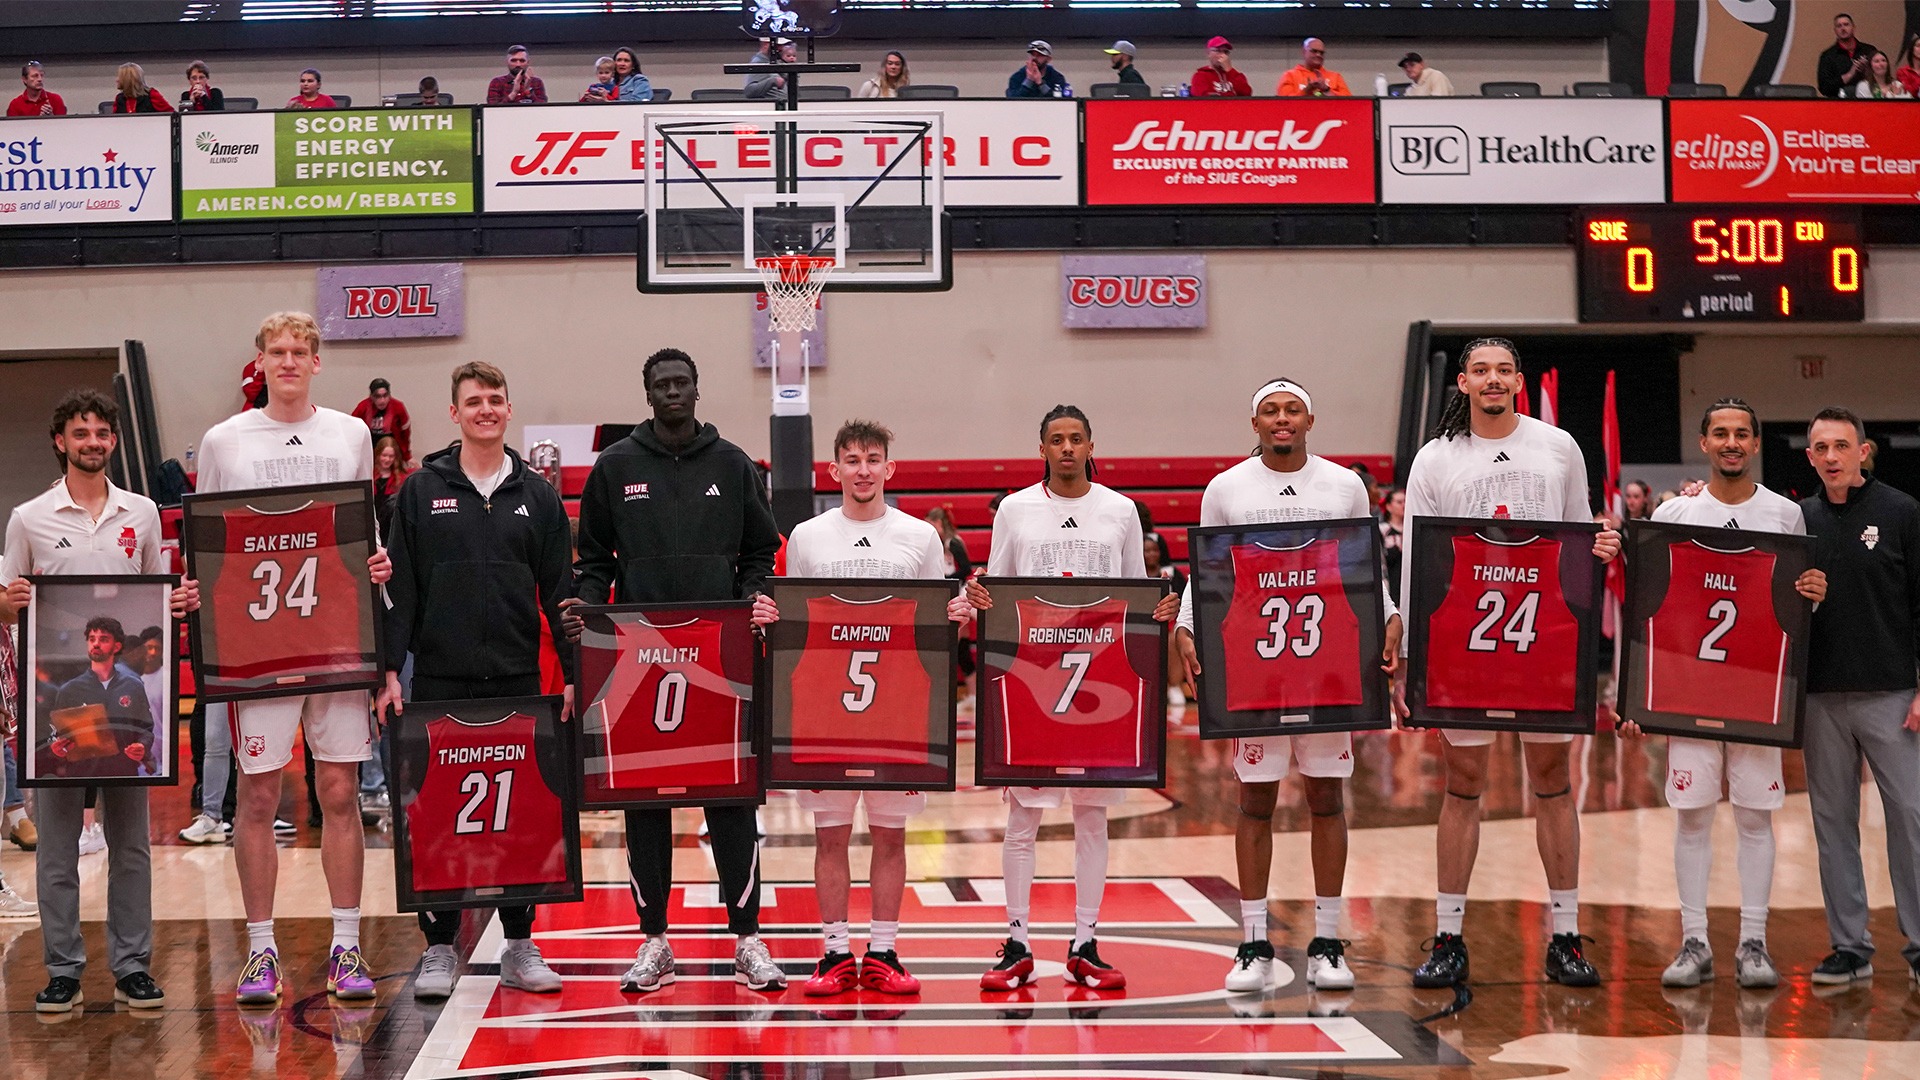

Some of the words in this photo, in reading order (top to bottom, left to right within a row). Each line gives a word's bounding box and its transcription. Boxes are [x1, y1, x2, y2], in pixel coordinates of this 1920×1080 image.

[295, 116, 378, 134] SCORE
[388, 114, 453, 131] WITH
[1112, 119, 1343, 151] Schnucks
[1783, 130, 1871, 153] Eclipse.
[210, 141, 259, 156] Ameren
[295, 138, 395, 156] ENERGY
[631, 135, 1052, 170] ELECTRIC
[1400, 136, 1459, 169] BJC
[1477, 135, 1656, 164] HealthCare
[1674, 133, 1766, 169] eclipse
[209, 156, 238, 164] ILLINOIS
[295, 159, 449, 179] EFFICIENCY.
[1113, 157, 1197, 170] EXCLUSIVE
[1200, 157, 1275, 170] GROCERY
[1278, 157, 1349, 169] PARTNER
[1689, 160, 1716, 170] CAR
[1784, 156, 1856, 174] You're
[1164, 172, 1180, 185] of
[1182, 172, 1205, 185] the
[1207, 172, 1239, 185] SIUE
[1242, 172, 1298, 187] Cougars
[20, 200, 41, 210] and
[44, 199, 56, 210] all
[59, 200, 84, 213] your
[86, 198, 122, 210] Loans.
[197, 192, 457, 212] AMEREN.COM/REBATES
[1693, 219, 1784, 262] 5:00
[1627, 247, 1654, 292] 0
[1832, 247, 1859, 292] 0
[343, 284, 438, 318] ROLL
[1066, 275, 1201, 308] COUGS
[1700, 292, 1754, 315] period
[1780, 285, 1790, 316] 1
[624, 483, 649, 494] SIUE
[432, 498, 458, 508] SIUE
[117, 538, 137, 548] SIUE
[244, 532, 318, 553] SAKENIS
[1258, 569, 1317, 589] VALRIE
[1473, 565, 1539, 583] THOMAS
[1703, 572, 1738, 592] HALL
[248, 556, 319, 621] 34
[1255, 593, 1326, 659] 33
[1467, 589, 1541, 653] 24
[1697, 598, 1738, 662] 2
[831, 625, 891, 642] CAMPION
[1028, 627, 1093, 643] ROBINSON
[1095, 627, 1115, 643] JR.
[638, 647, 699, 664] MALITH
[841, 650, 880, 713] 5
[1052, 651, 1092, 714] 7
[653, 671, 688, 733] 0
[438, 744, 526, 765] THOMPSON
[455, 769, 514, 835] 21
